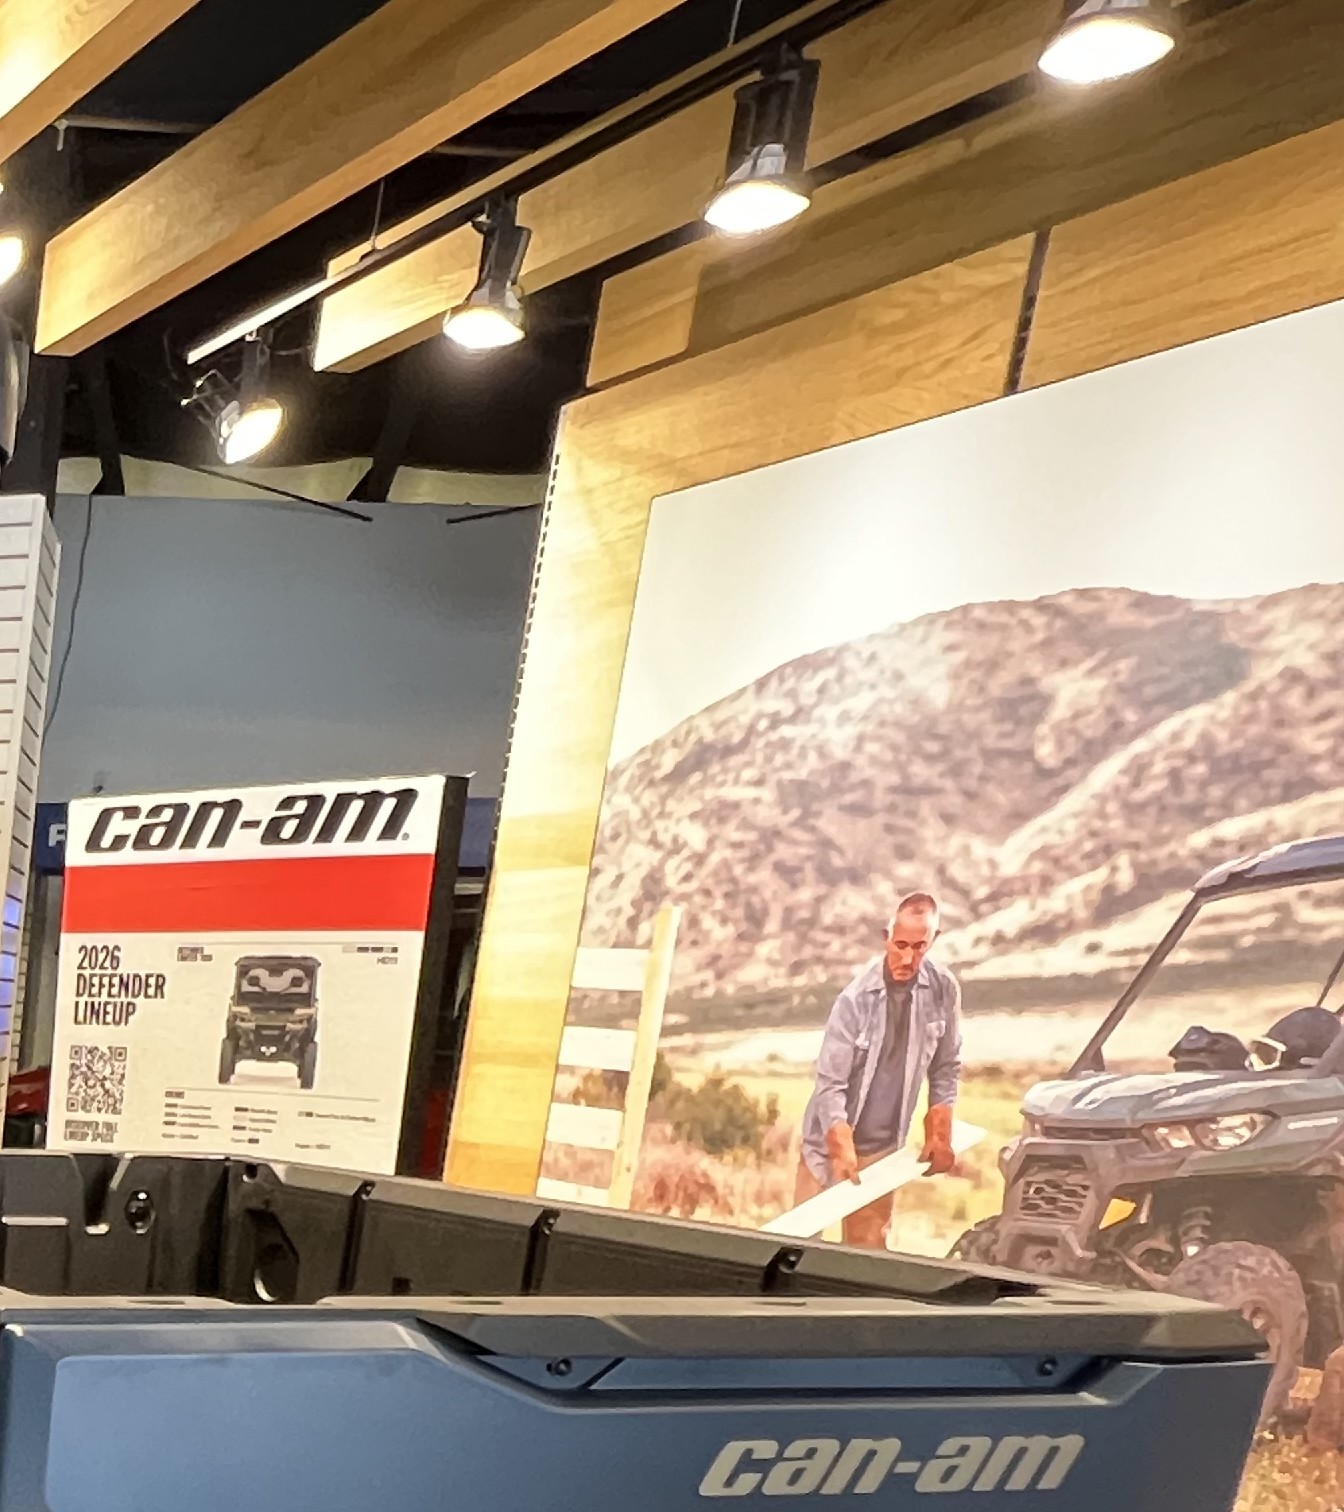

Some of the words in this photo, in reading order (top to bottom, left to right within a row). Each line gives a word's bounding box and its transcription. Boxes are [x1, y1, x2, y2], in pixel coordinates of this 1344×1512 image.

[84, 788, 419, 854] can-am
[77, 944, 122, 971] 2026
[75, 973, 166, 1000] DEFENDER
[74, 1000, 137, 1027] LINEUP
[698, 1433, 1086, 1497] can-am
